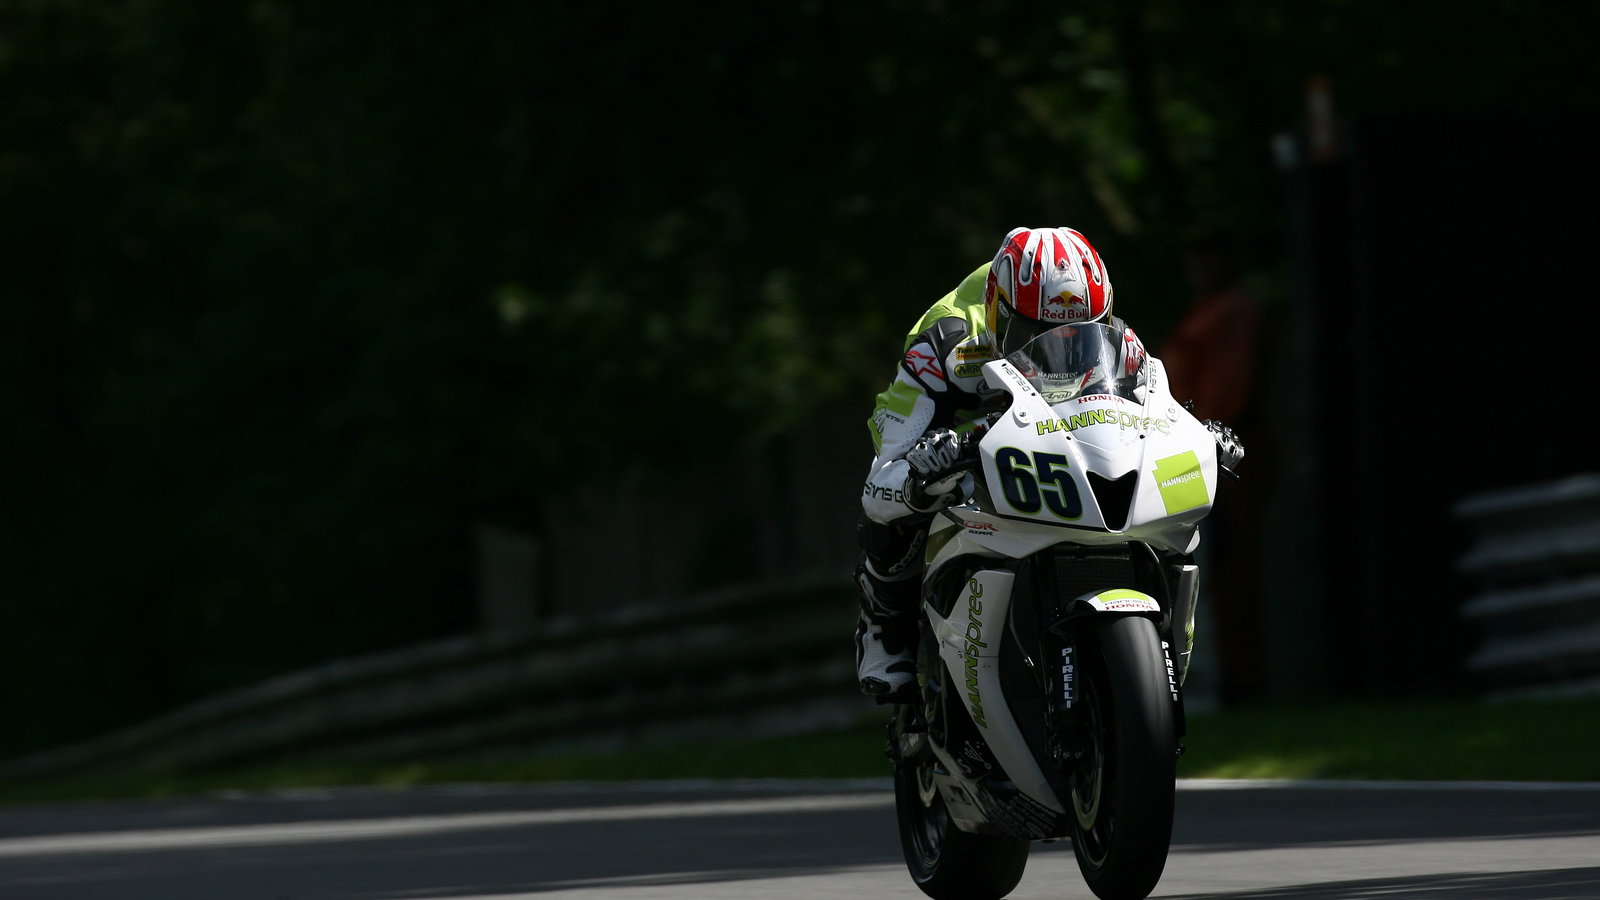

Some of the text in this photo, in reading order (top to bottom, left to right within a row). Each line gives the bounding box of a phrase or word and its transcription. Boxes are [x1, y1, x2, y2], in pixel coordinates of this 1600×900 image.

[1041, 307, 1088, 319] Red Bull
[1077, 394, 1126, 405] HONDA
[1036, 409, 1171, 436] HANNspree
[995, 446, 1083, 521] 65
[1161, 470, 1201, 488] HANNspree
[1105, 603, 1155, 612] HONDA
[964, 577, 988, 729] HANNspree
[1061, 647, 1074, 709] PIRELLI
[1161, 640, 1178, 702] PIRELLI
